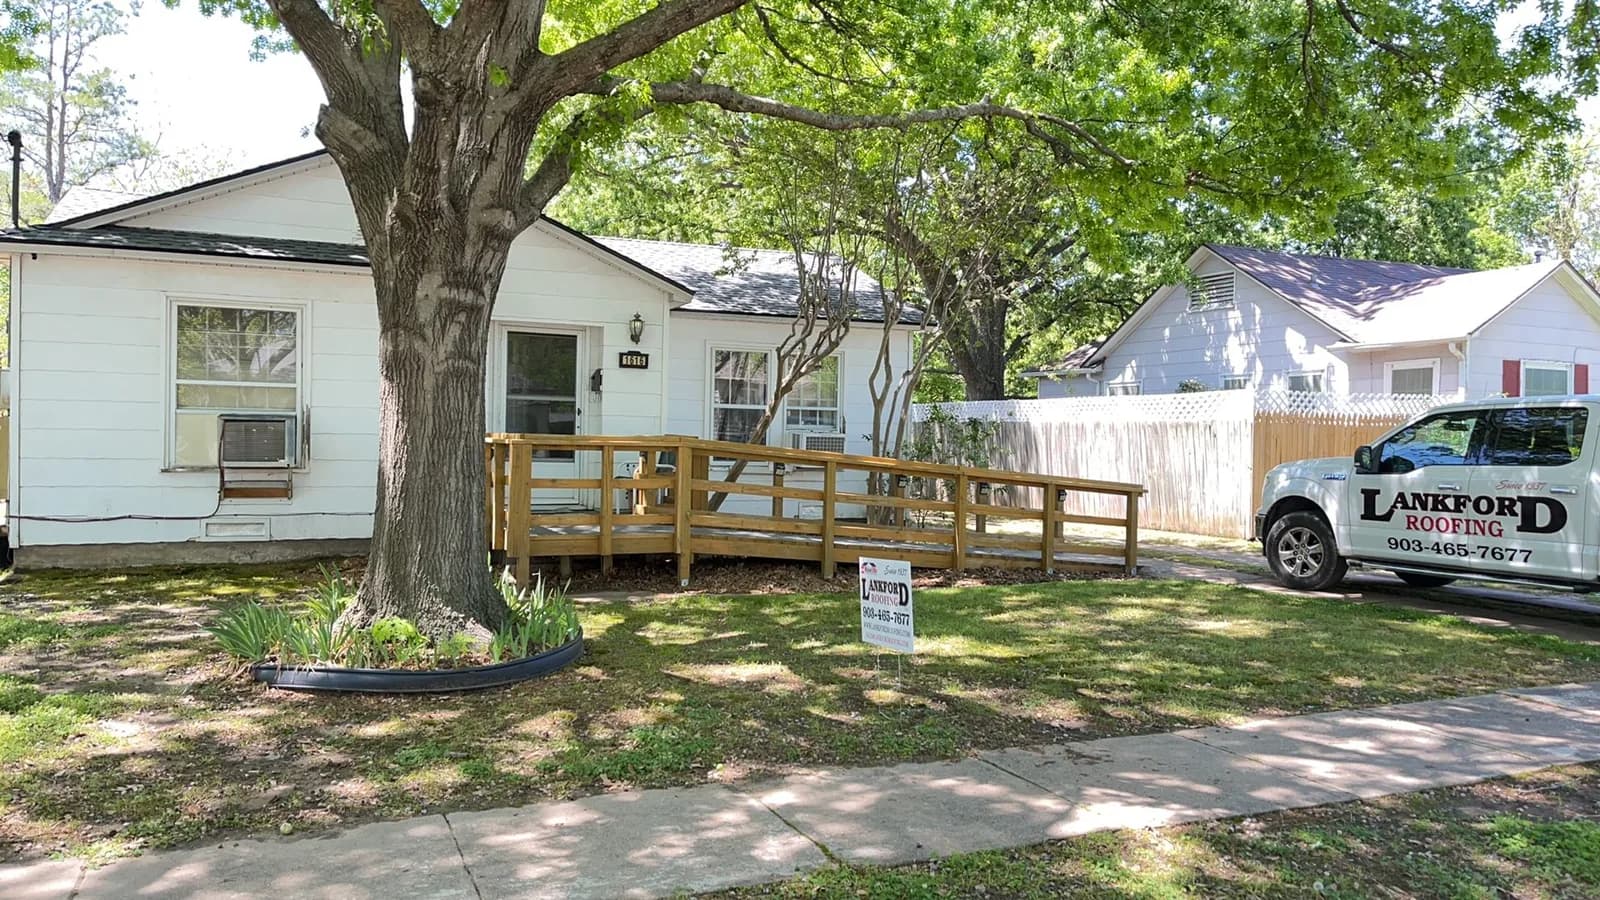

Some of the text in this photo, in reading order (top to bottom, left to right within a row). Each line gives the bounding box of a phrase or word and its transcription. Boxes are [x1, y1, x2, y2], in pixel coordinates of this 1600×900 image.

[1495, 479, 1522, 490] Since
[1405, 514, 1504, 538] ROOFING
[1387, 537, 1533, 563] 903-465-7677
[870, 593, 899, 607] ROOFING
[863, 606, 910, 626] 903-465-7677
